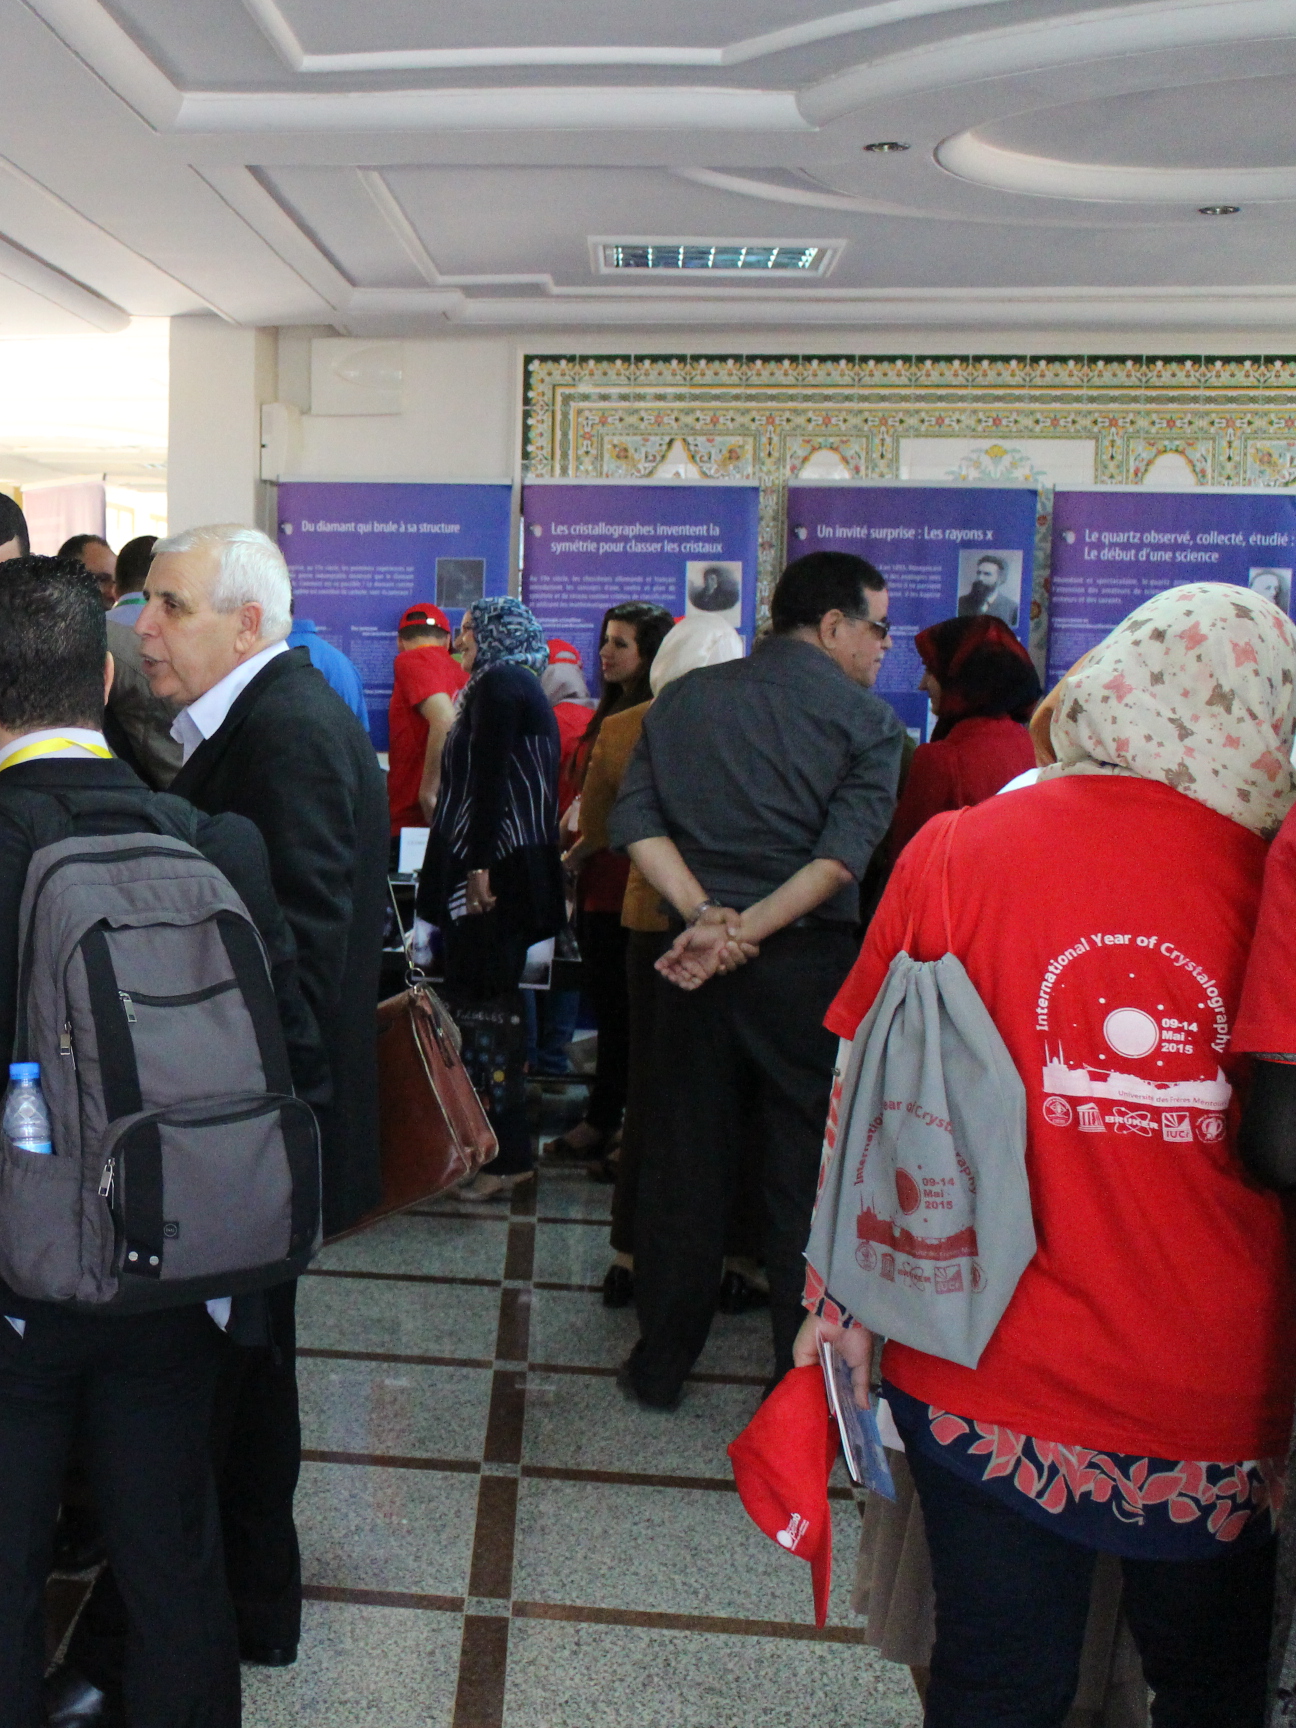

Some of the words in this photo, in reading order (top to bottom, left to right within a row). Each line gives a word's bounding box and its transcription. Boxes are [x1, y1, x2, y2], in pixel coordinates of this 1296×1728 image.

[301, 520, 314, 532] Du
[316, 520, 355, 532] diamant
[357, 521, 372, 535] qui
[399, 521, 406, 533] à
[407, 523, 417, 533] sa
[419, 522, 461, 533] structure
[551, 522, 568, 535] Les
[570, 522, 654, 538] cristallographes
[657, 523, 708, 536] inventent
[709, 523, 720, 536] la
[817, 525, 833, 538] Un
[835, 525, 868, 539] invité
[870, 526, 915, 542] surprise
[924, 526, 943, 540] Les
[945, 528, 983, 543] rayons
[1085, 529, 1099, 542] Le
[1101, 531, 1140, 547] quartz
[1143, 530, 1194, 546] observé,
[1196, 530, 1246, 547] collecté,
[1249, 531, 1289, 546] étudié
[551, 539, 597, 555] symétrie
[599, 541, 624, 555] pour
[626, 540, 662, 553] classer
[664, 540, 679, 553] les
[681, 540, 722, 553] cristaux
[1084, 546, 1098, 560] Le
[1100, 547, 1135, 561] début
[1138, 548, 1172, 562] d'une
[1175, 549, 1219, 563] science
[1036, 938, 1091, 1032] International
[1091, 932, 1132, 948] Year
[1136, 935, 1158, 949] of
[1160, 942, 1231, 1054] Crystalography
[1162, 1018, 1198, 1032] 09-14
[1162, 1030, 1185, 1041] Mai
[1161, 1042, 1194, 1054] 2015
[883, 1100, 903, 1111] ear
[1105, 1114, 1159, 1130] BRUKER
[922, 1177, 955, 1187] 09-14
[923, 1189, 944, 1198] Mai
[925, 1200, 953, 1210] 2015
